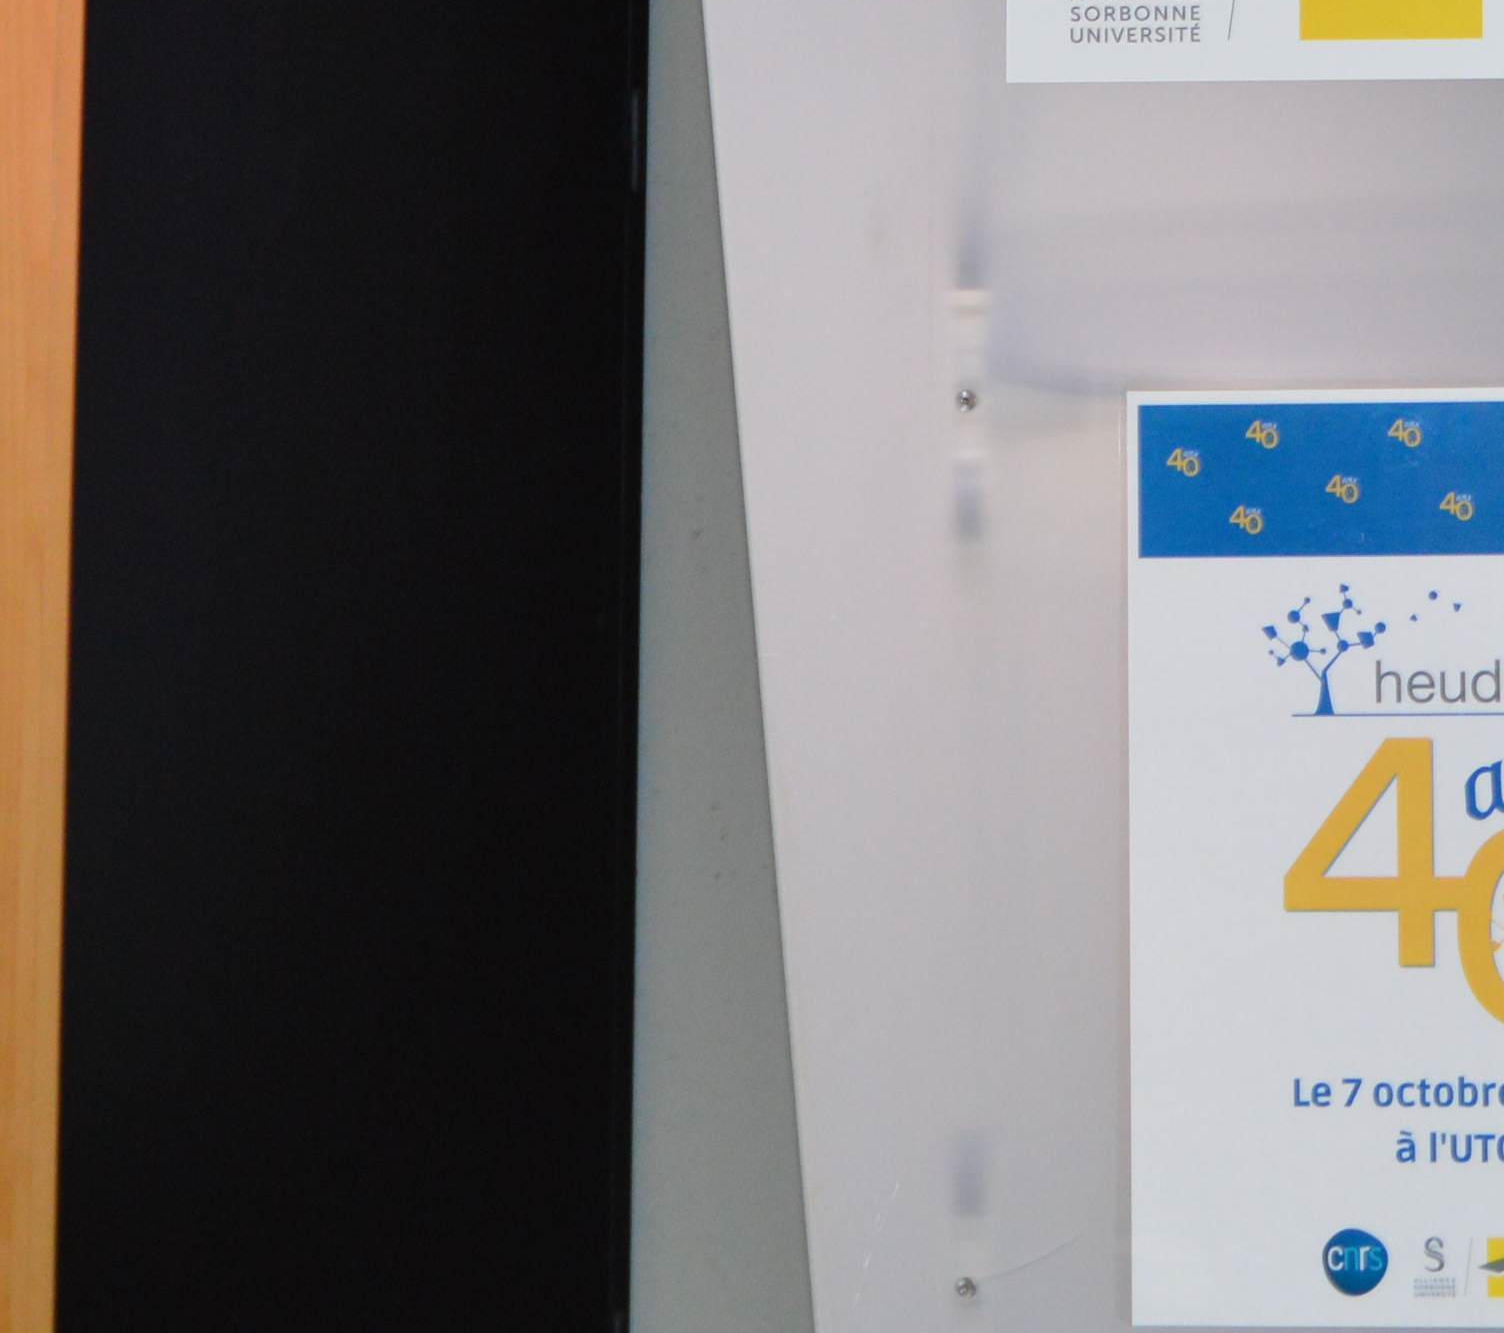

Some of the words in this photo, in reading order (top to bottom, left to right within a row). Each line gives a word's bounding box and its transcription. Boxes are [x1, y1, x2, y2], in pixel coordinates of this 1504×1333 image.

[1070, 5, 1202, 22] SORBONNE
[1070, 22, 1202, 44] UNIVERSITÉ
[1245, 420, 1278, 449] 40
[1388, 418, 1422, 447] 40
[1166, 448, 1200, 477] 40
[1326, 475, 1358, 504] 40
[1229, 505, 1262, 535] 40
[1440, 492, 1474, 521] 40
[1293, 1078, 1332, 1108] Le
[1342, 1078, 1363, 1108] 7
[1395, 1130, 1416, 1164] à
[1327, 1245, 1384, 1272] cnrs
